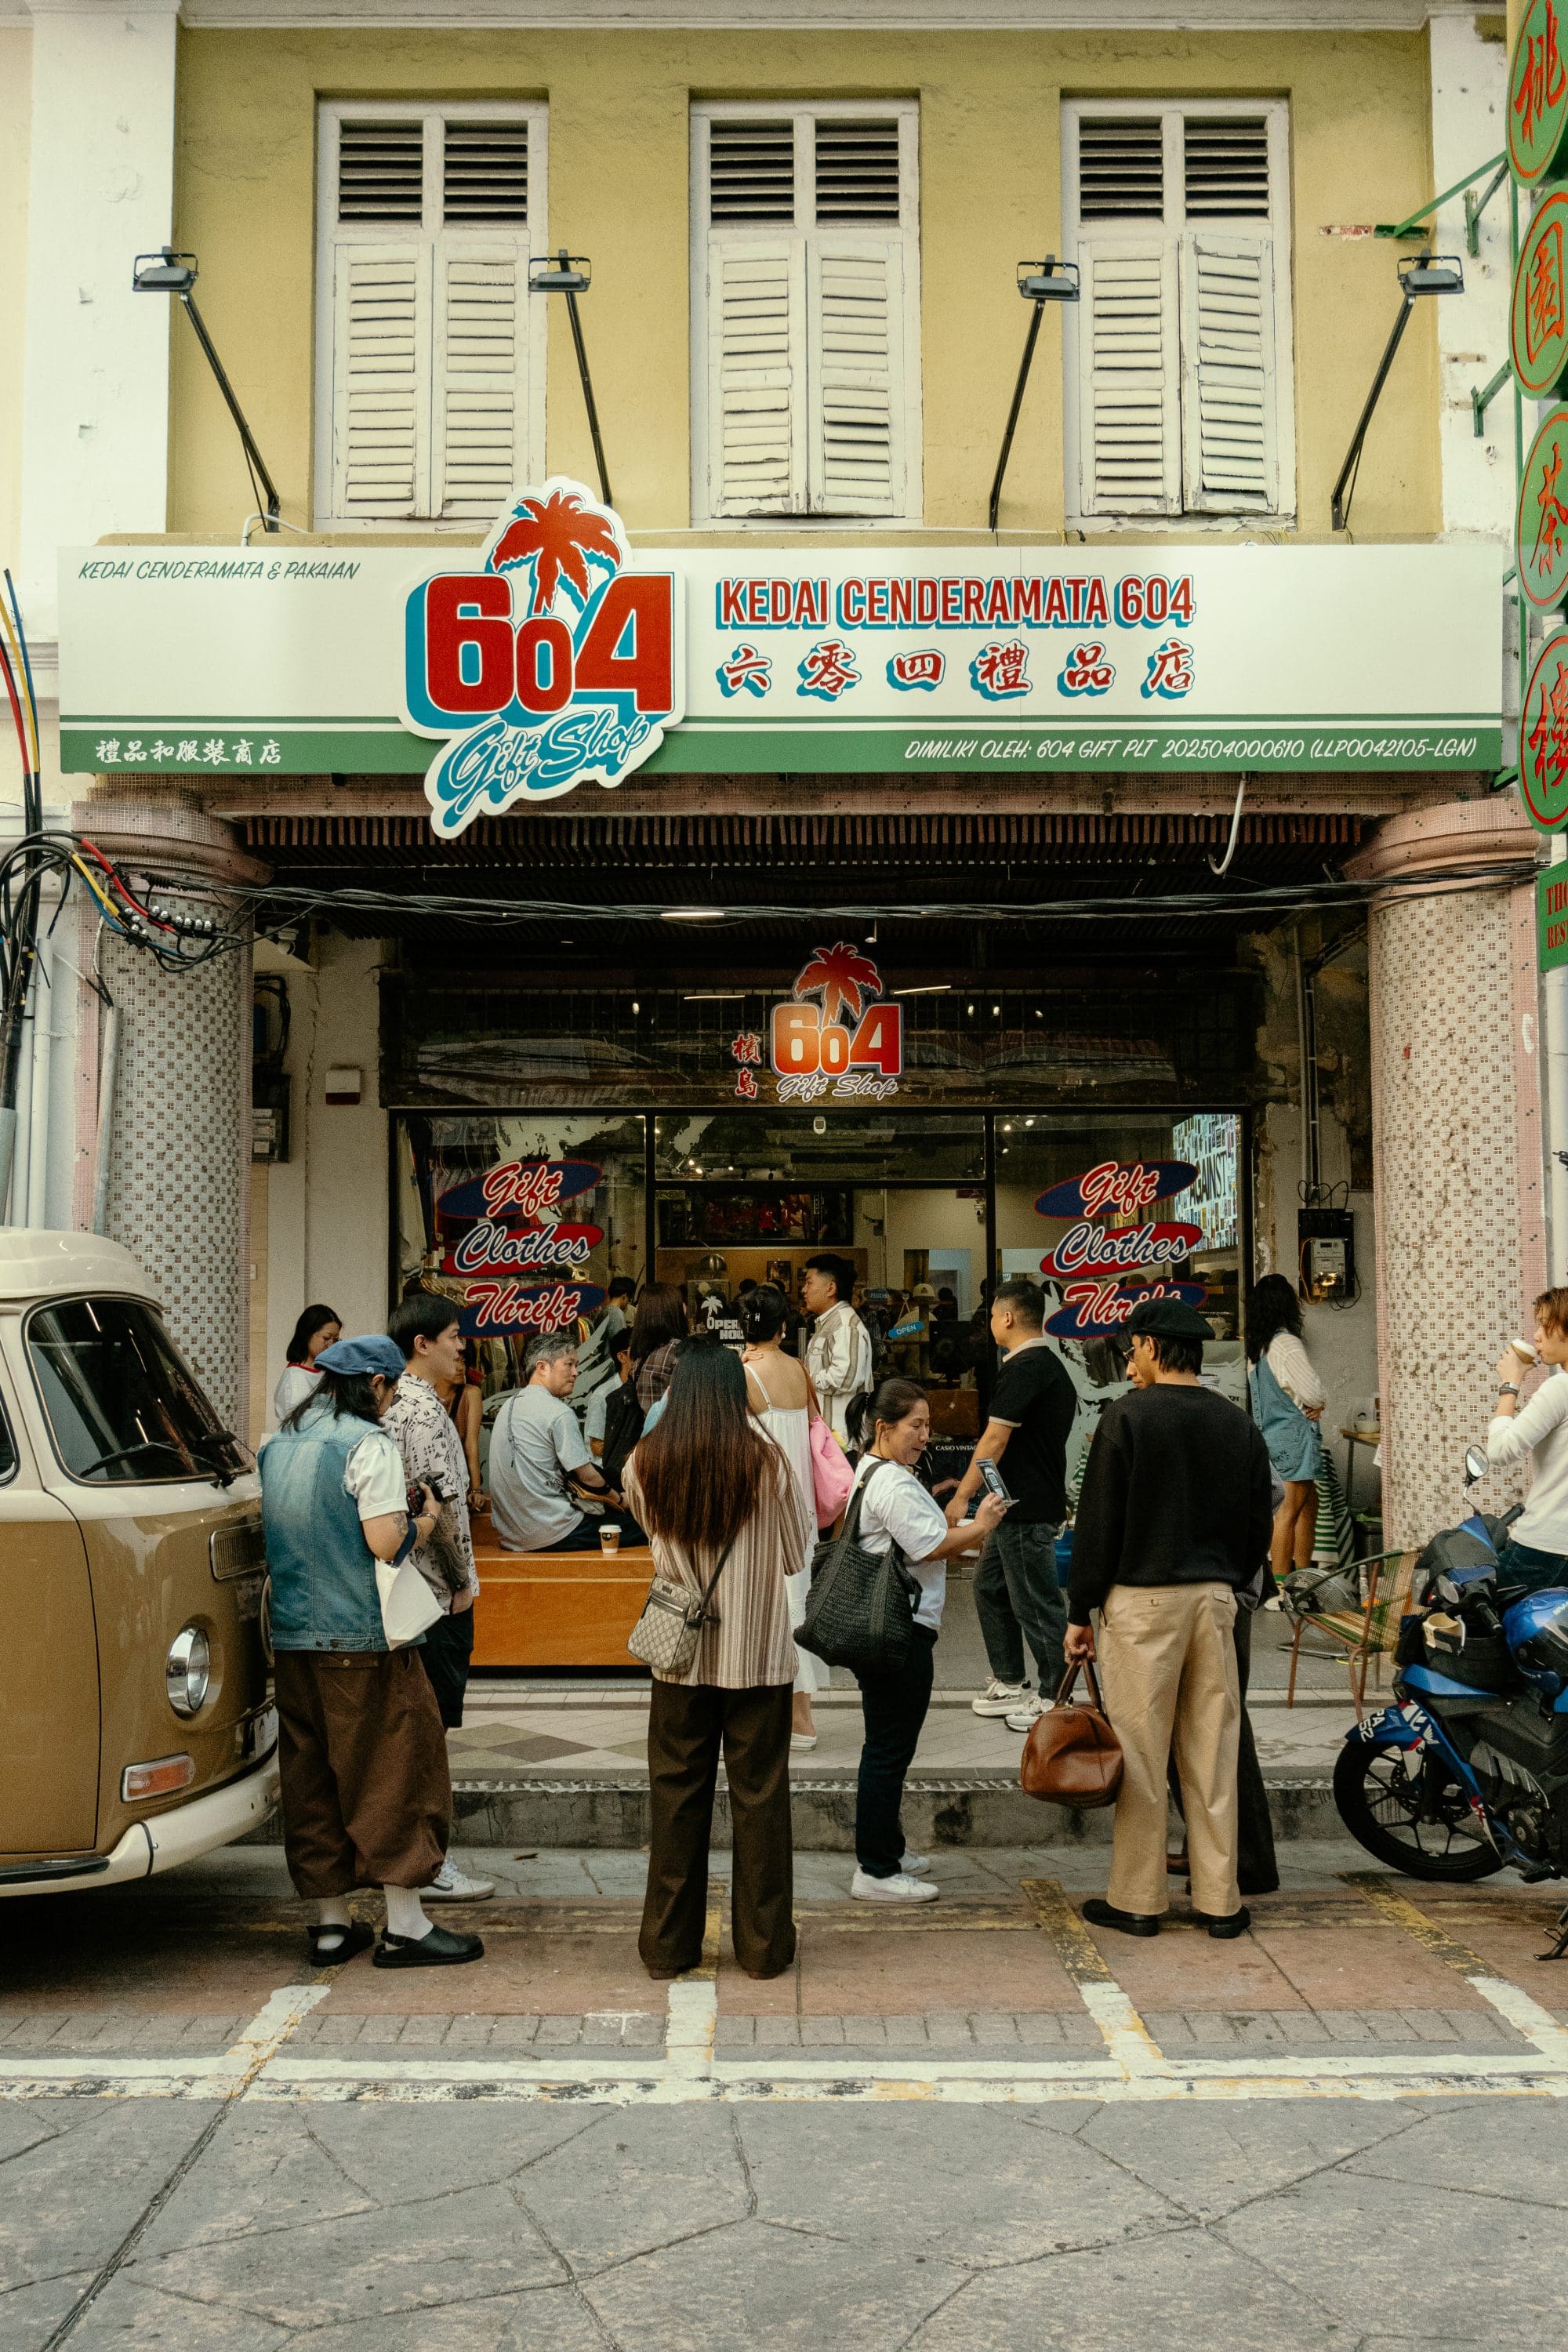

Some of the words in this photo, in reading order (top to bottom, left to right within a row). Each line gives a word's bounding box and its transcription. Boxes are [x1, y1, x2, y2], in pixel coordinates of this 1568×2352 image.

[78, 561, 133, 579] KEDAI
[136, 561, 263, 580] CENDERAMATA
[267, 561, 281, 580] &
[283, 561, 361, 580] PAKAIAN
[717, 577, 830, 630] KEDAI
[837, 575, 1111, 629] CENDERAMATA
[1114, 574, 1196, 627] 604
[405, 572, 677, 731] 604
[717, 637, 1196, 701] 六零四禮品店
[96, 738, 281, 765] 禮品和服裝商店
[442, 717, 539, 823] Gift
[532, 709, 652, 782] Shop
[905, 739, 978, 759] DIMILIKI
[980, 739, 1032, 759] OLEH:
[1036, 739, 1074, 759] 604
[1078, 739, 1122, 759] GIFT
[1122, 739, 1158, 758] PLT
[1161, 739, 1305, 759] 202504000610
[1310, 738, 1478, 759] (LLP0042105-LGN)
[771, 1003, 902, 1076] 604
[776, 1073, 827, 1103] Gift
[831, 1073, 899, 1101] Shop
[481, 1161, 563, 1219] Gift
[1079, 1161, 1160, 1218] Gift
[454, 1221, 591, 1273] Clothes
[1053, 1221, 1190, 1273] Clothes
[464, 1282, 582, 1334] Thrift
[896, 1324, 916, 1335] OPEN
[1064, 1282, 1181, 1328] Thr
[719, 1330, 745, 1340] HOU
